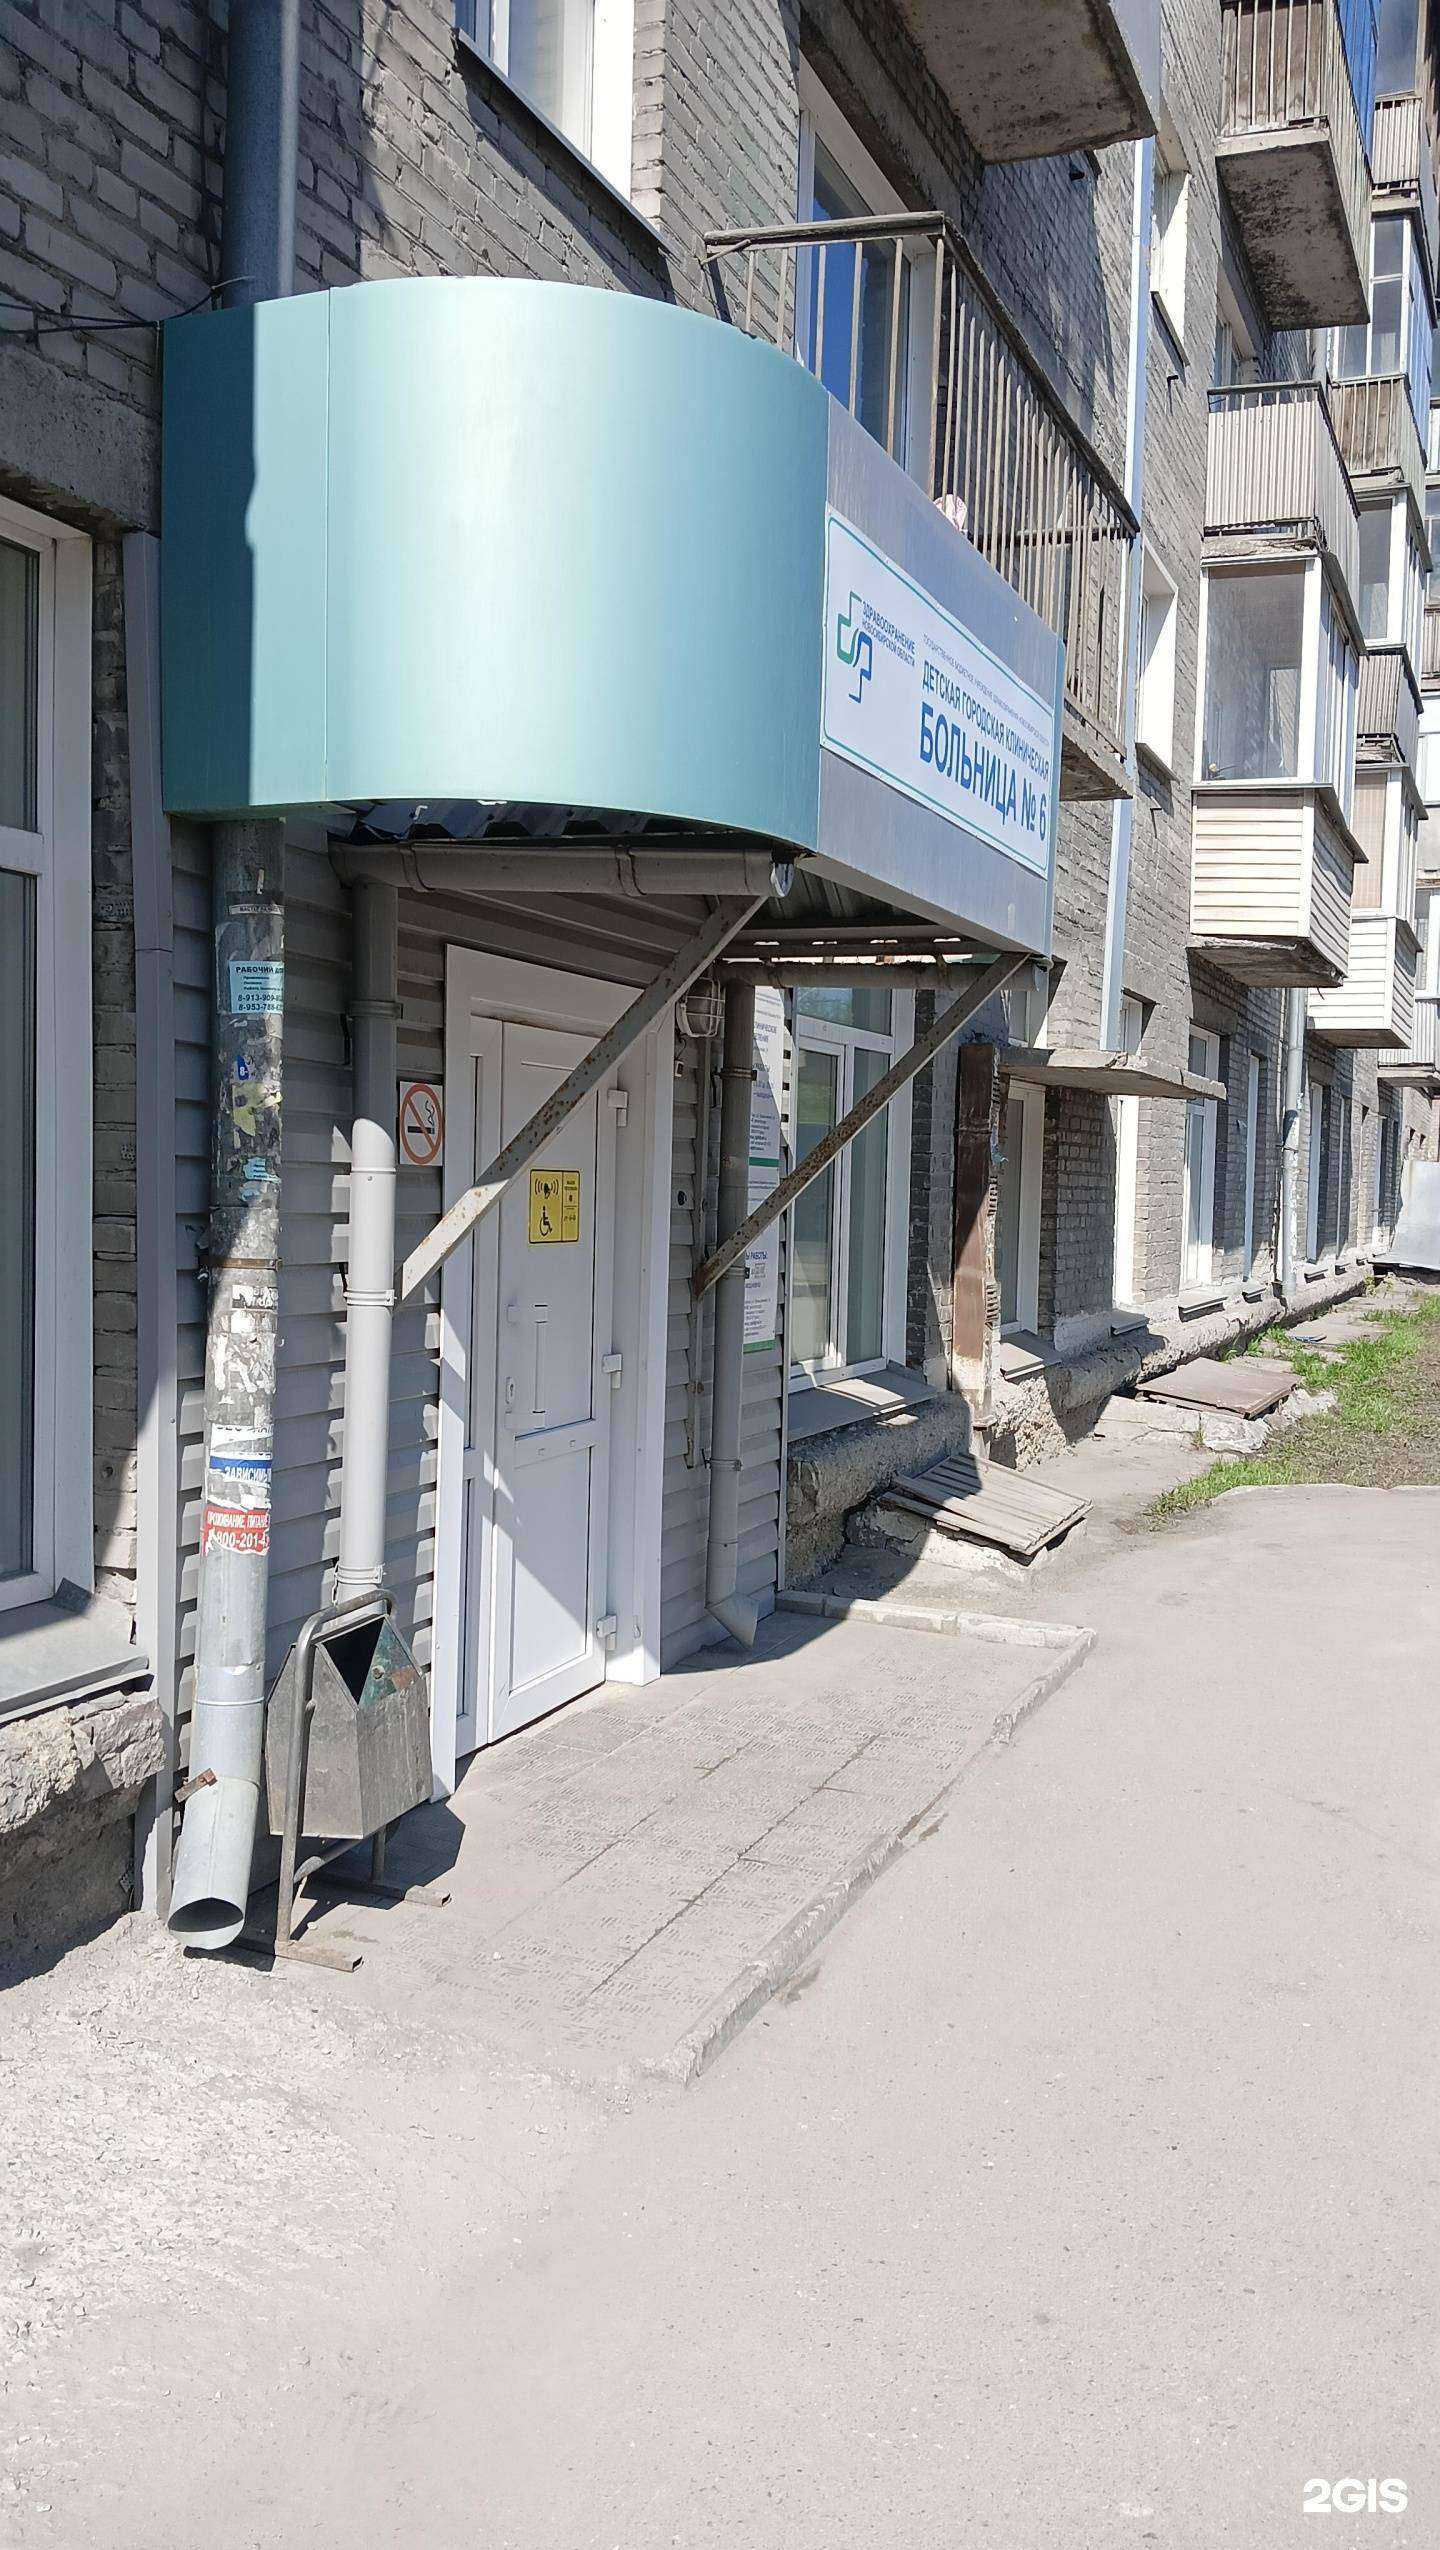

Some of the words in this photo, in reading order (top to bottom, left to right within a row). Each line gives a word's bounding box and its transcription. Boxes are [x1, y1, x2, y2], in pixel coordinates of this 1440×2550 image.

[920, 701, 1017, 826] БОЛЬНИЦА
[1021, 778, 1036, 832] №
[1040, 793, 1047, 841] 6
[922, 660, 961, 714] ДЕТСКАЯ
[961, 689, 1005, 745] ГОРОДСКАЯ
[1005, 726, 1049, 782] КЛИНИЧЕСКАЯ
